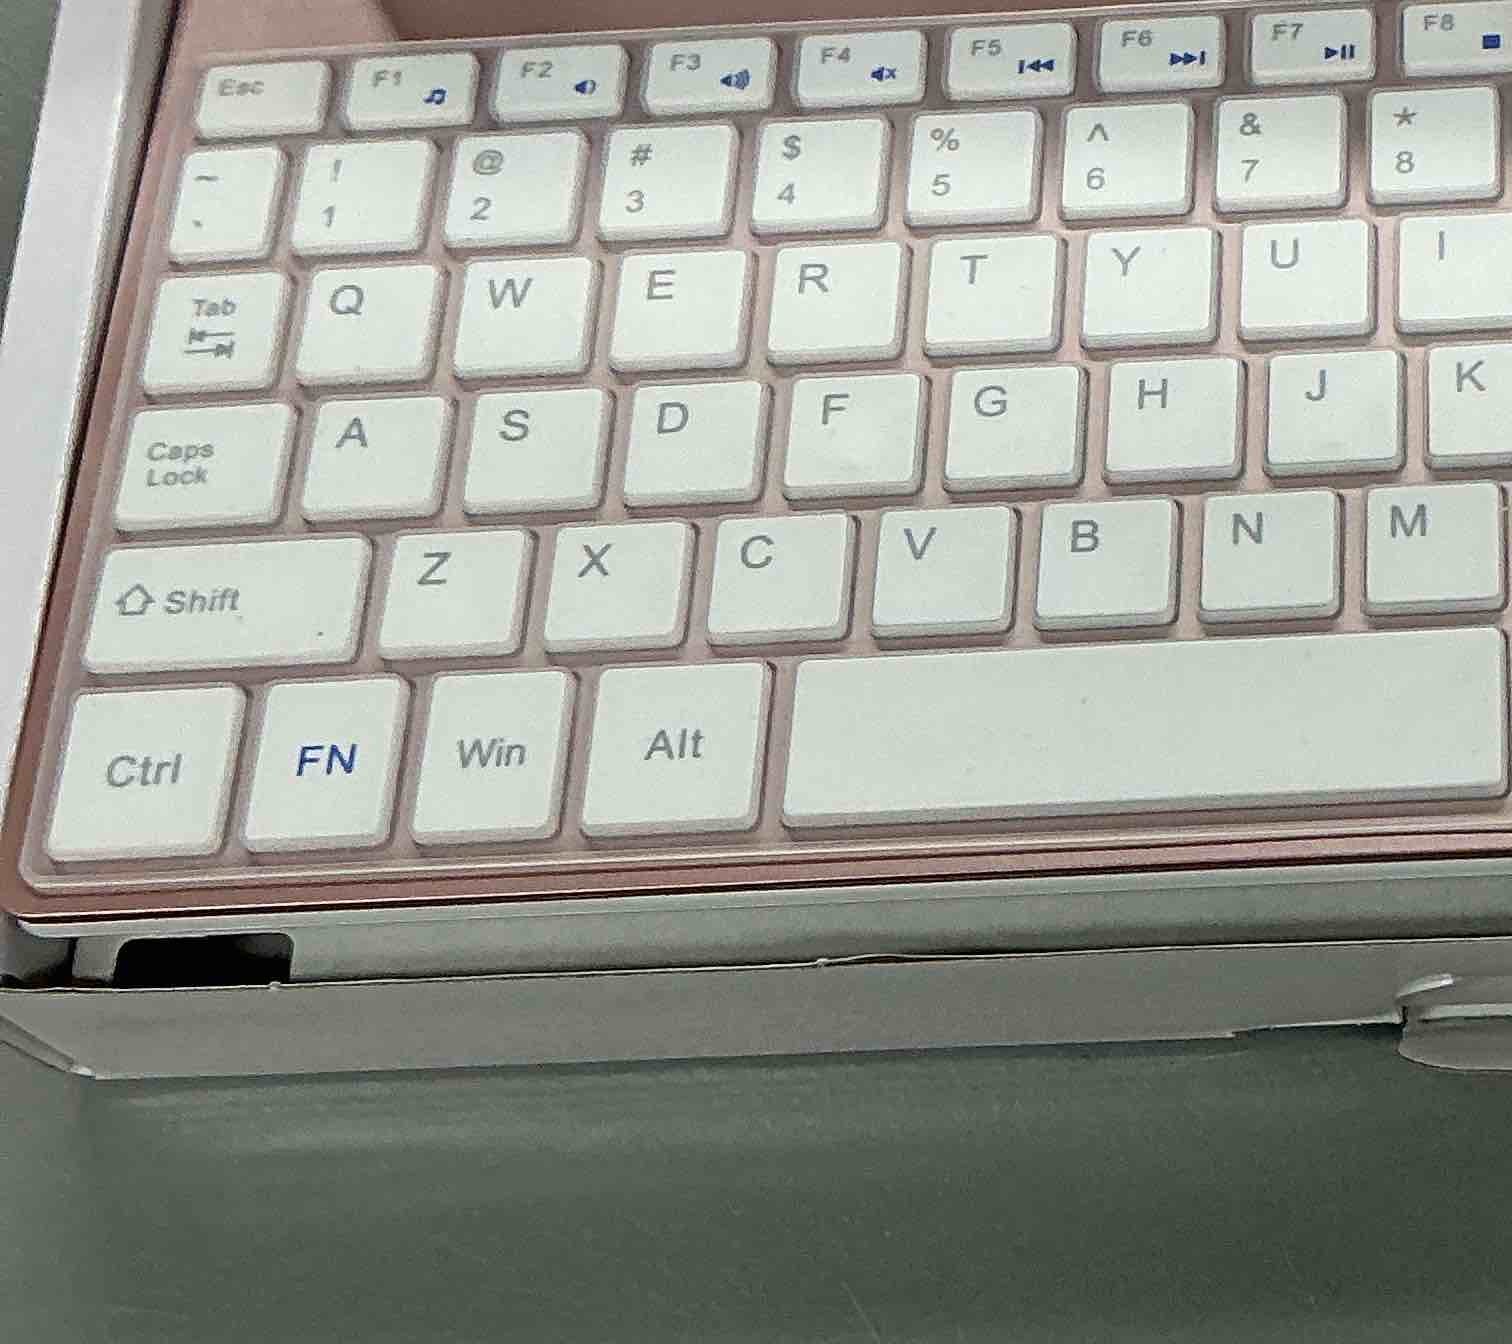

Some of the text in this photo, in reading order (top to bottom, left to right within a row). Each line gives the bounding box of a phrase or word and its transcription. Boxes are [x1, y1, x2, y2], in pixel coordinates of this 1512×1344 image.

[1121, 29, 1153, 48] F6
[1271, 22, 1304, 41] F7
[1423, 13, 1455, 32] F8
[669, 53, 702, 72] F3
[820, 46, 851, 65] F4
[970, 38, 1003, 57] F5
[372, 69, 403, 88] F1
[520, 60, 554, 79] F2
[217, 77, 265, 97] Esc
[1086, 166, 1106, 191] 6
[1240, 158, 1260, 183] 7
[1395, 150, 1415, 175] 8
[776, 182, 796, 205] 4
[931, 173, 951, 197] 5
[322, 205, 336, 229] 1
[469, 196, 492, 221] 2
[625, 189, 645, 214] 3
[959, 254, 989, 285] T
[1110, 245, 1142, 277] Y
[1270, 237, 1300, 270] U
[488, 277, 534, 310] W
[646, 269, 677, 301] E
[797, 263, 829, 294] R
[192, 297, 237, 318] Tab
[329, 284, 365, 316] Q
[1304, 369, 1327, 402] J
[1455, 359, 1486, 393] K
[821, 393, 850, 426] F
[973, 385, 1008, 418] G
[1137, 378, 1169, 411] H
[334, 416, 368, 449] A
[499, 408, 530, 442] S
[656, 401, 689, 435] D
[145, 441, 215, 464] Caps
[146, 465, 208, 488] Lock
[1070, 519, 1100, 553] B
[1232, 511, 1264, 546] N
[1390, 503, 1428, 539] M
[740, 534, 775, 570] C
[903, 526, 938, 561] V
[416, 551, 452, 586] Z
[577, 543, 613, 578] X
[163, 587, 240, 615] Shift
[296, 743, 357, 777] FN
[456, 737, 527, 769] Win
[643, 728, 704, 761] Alt
[105, 752, 183, 789] Ctrl
